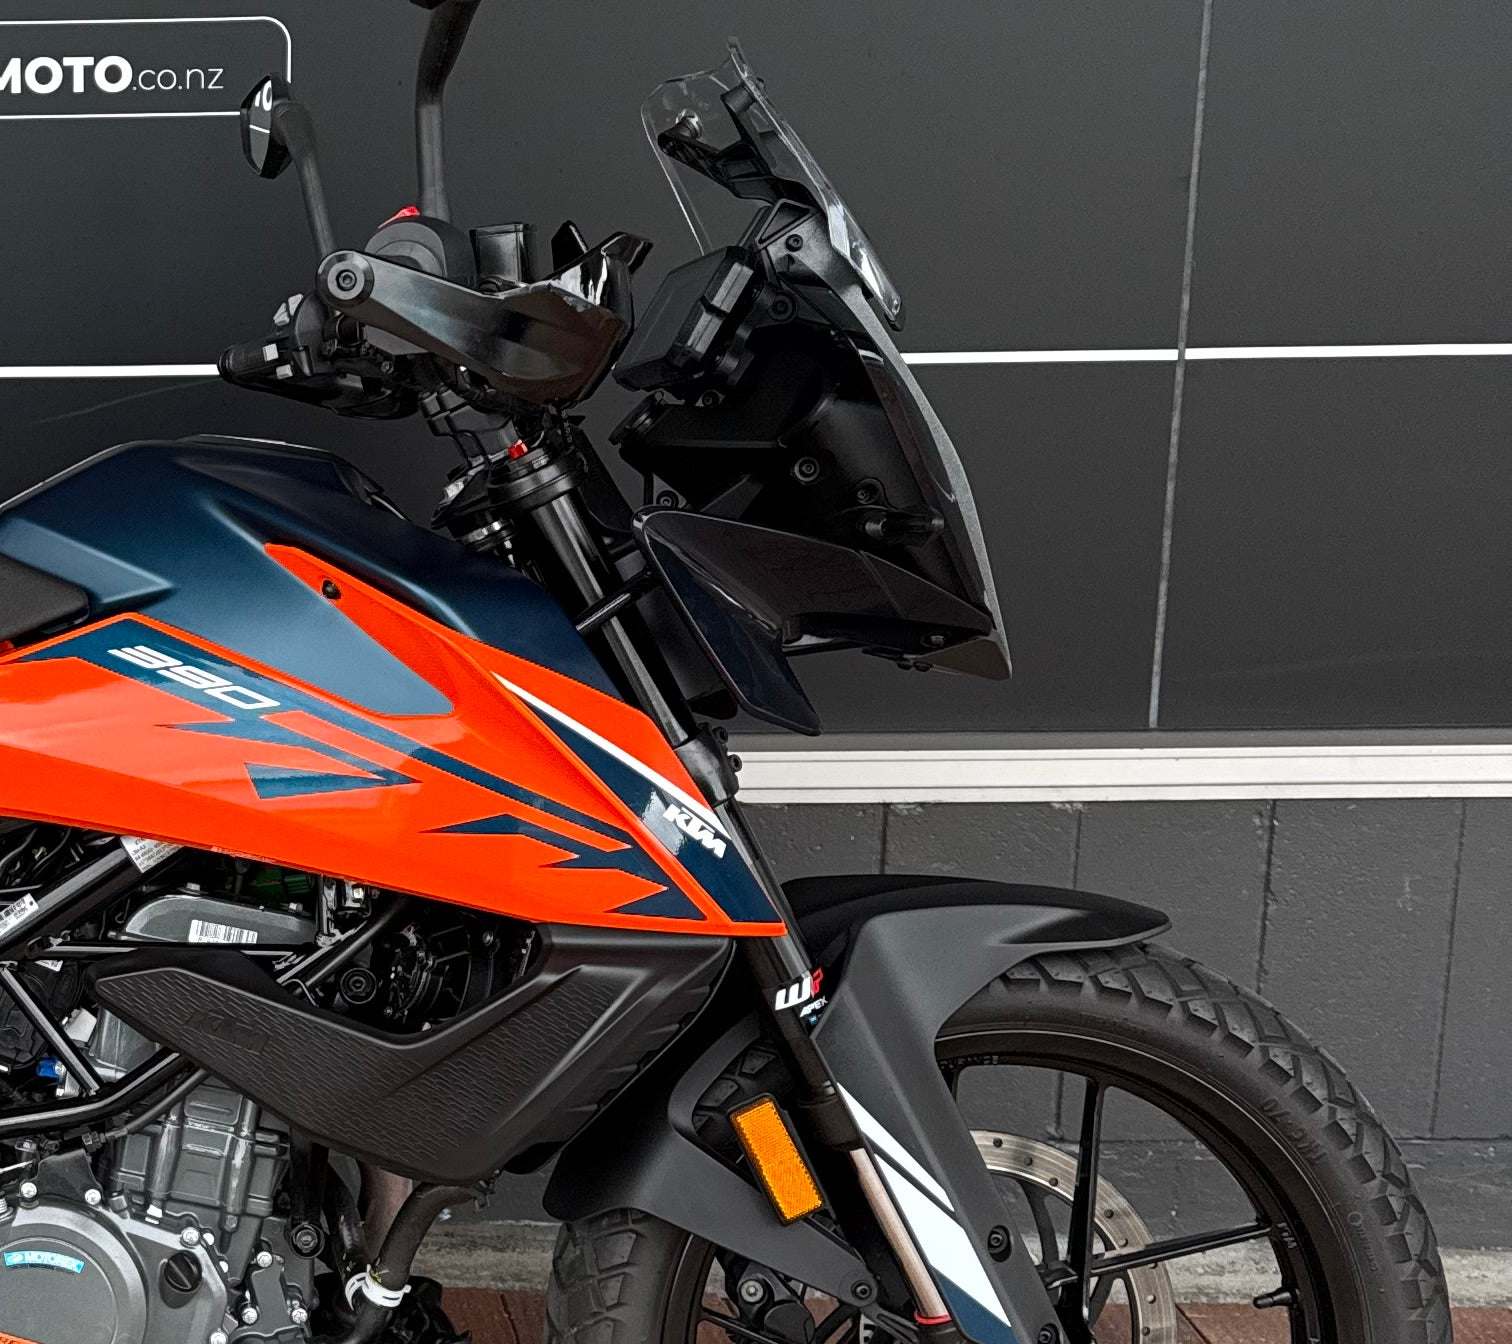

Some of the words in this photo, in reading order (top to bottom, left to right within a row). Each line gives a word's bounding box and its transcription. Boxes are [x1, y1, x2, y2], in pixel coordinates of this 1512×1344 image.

[108, 646, 280, 709] 390
[663, 804, 727, 859] KTM
[800, 996, 828, 1017] APEX
